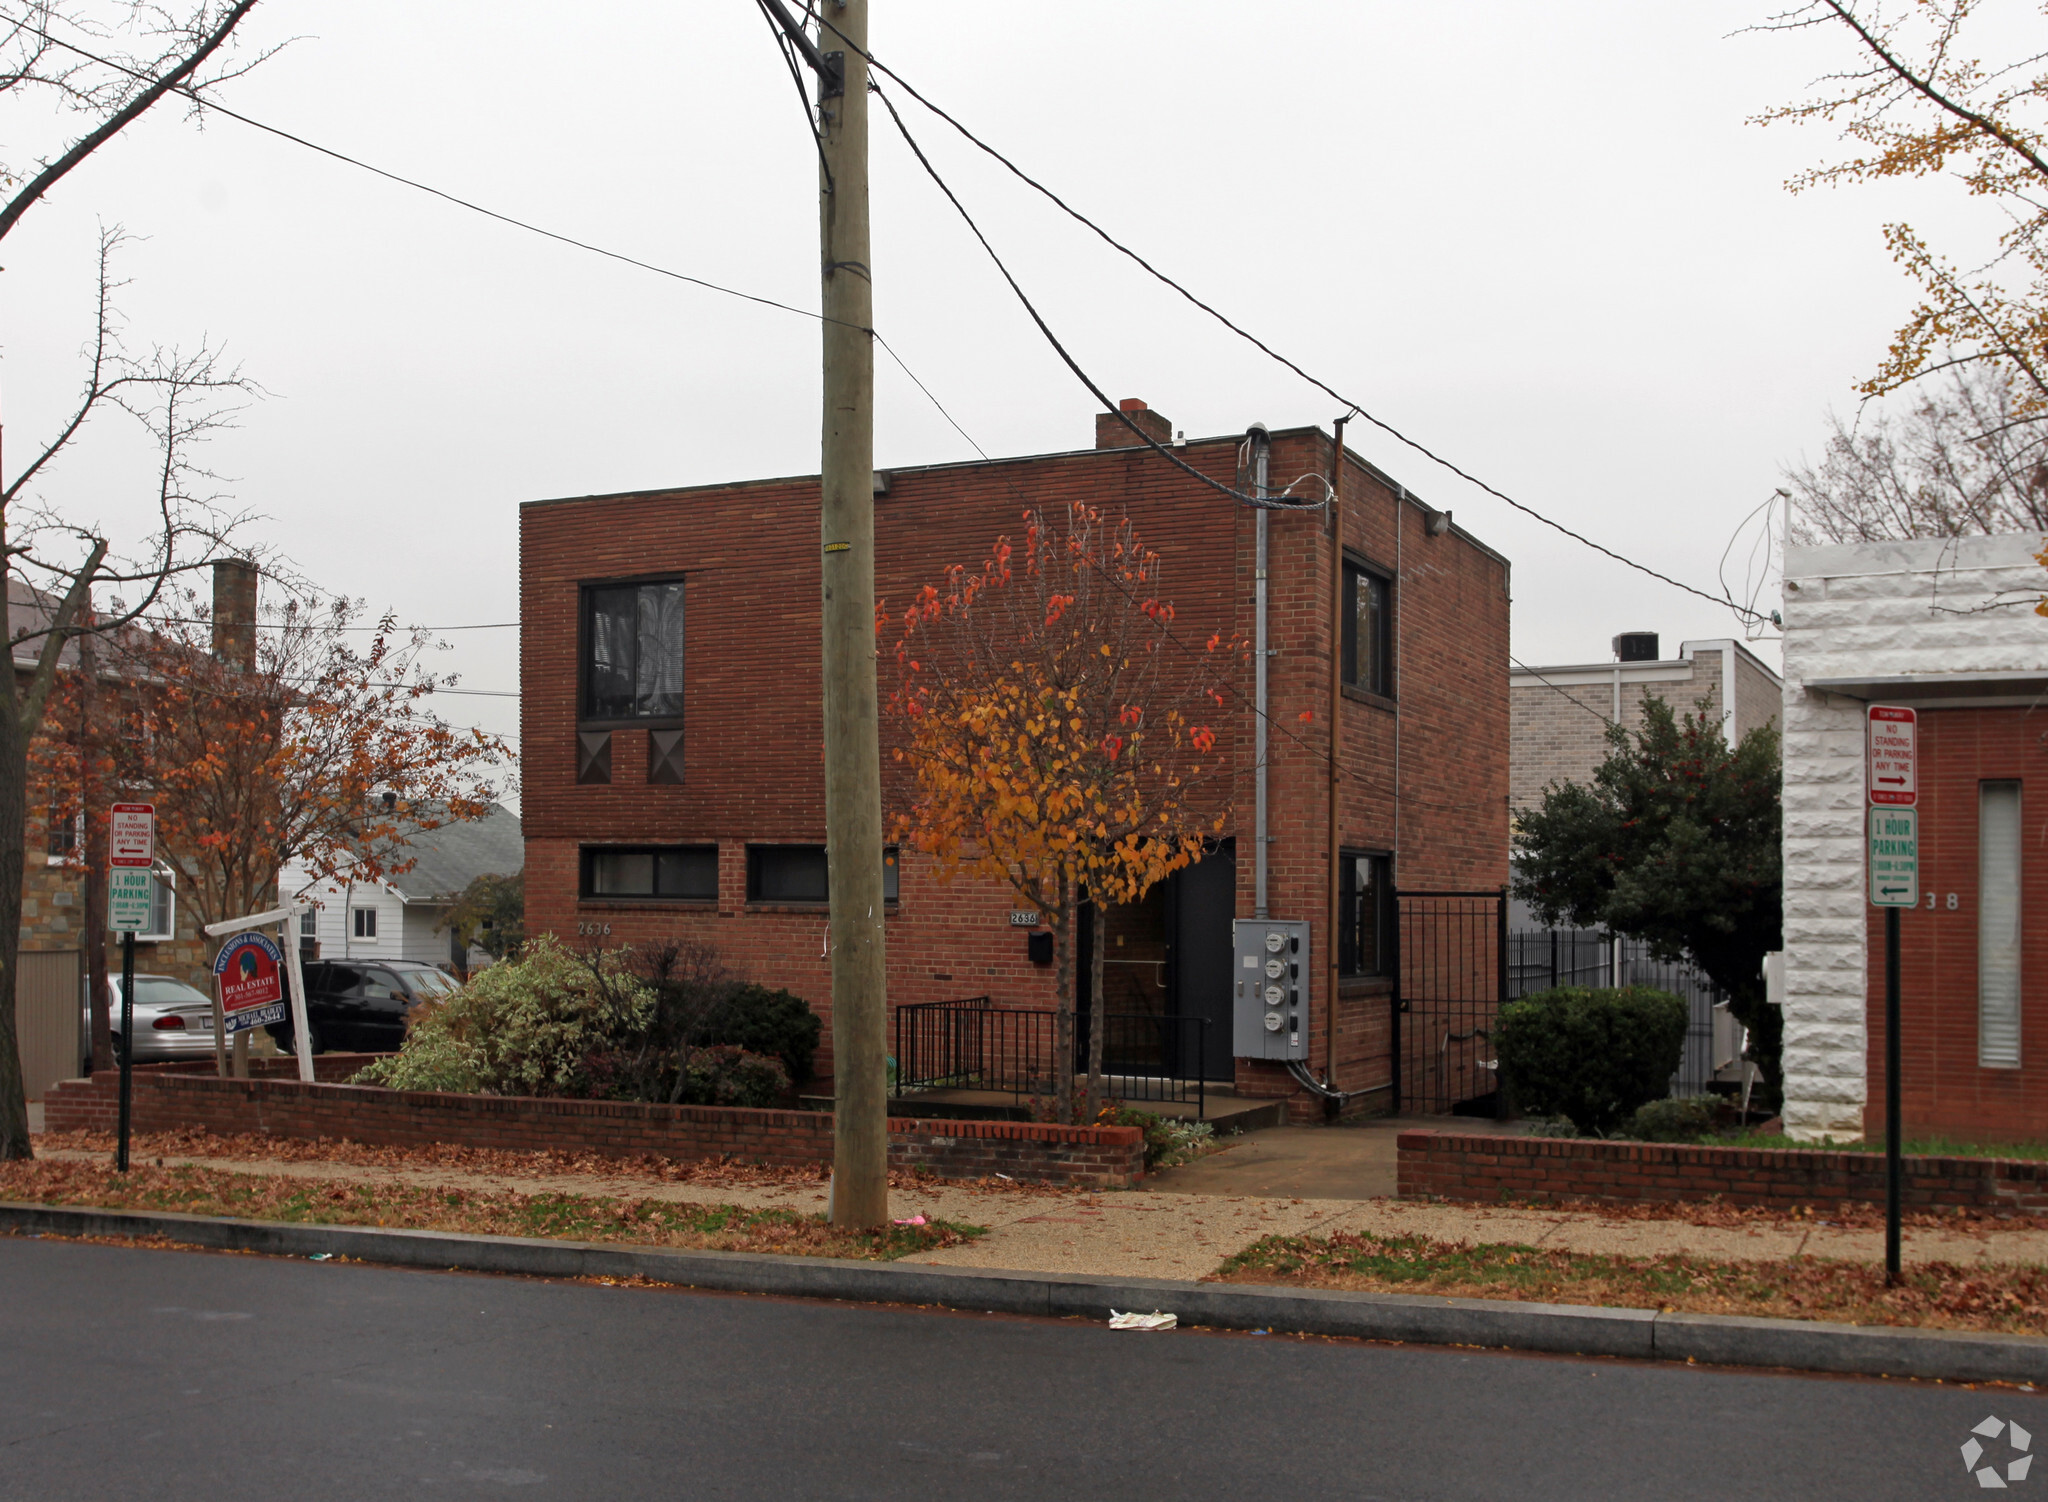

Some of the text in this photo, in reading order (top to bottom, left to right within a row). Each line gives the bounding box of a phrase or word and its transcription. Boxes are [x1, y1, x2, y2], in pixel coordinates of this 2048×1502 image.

[1886, 725, 1898, 734] NO
[1875, 736, 1910, 747] STANDING
[1872, 749, 1913, 760] OR PARKING
[1875, 762, 1910, 773] ANY TIME
[117, 822, 149, 830] STANDING
[1876, 818, 1911, 836] 1 HOUR
[125, 830, 151, 838] PARKING
[1872, 839, 1914, 857] PARKING
[115, 875, 147, 887] 1 HOUR
[111, 888, 149, 900] PARKING
[1012, 913, 1036, 923] 2636
[578, 921, 611, 935] 2636
[217, 934, 278, 972] INCLUSIONS & ASSOCIATES
[225, 976, 275, 995] REAL ESTATE
[249, 1012, 281, 1026] 460-2644
